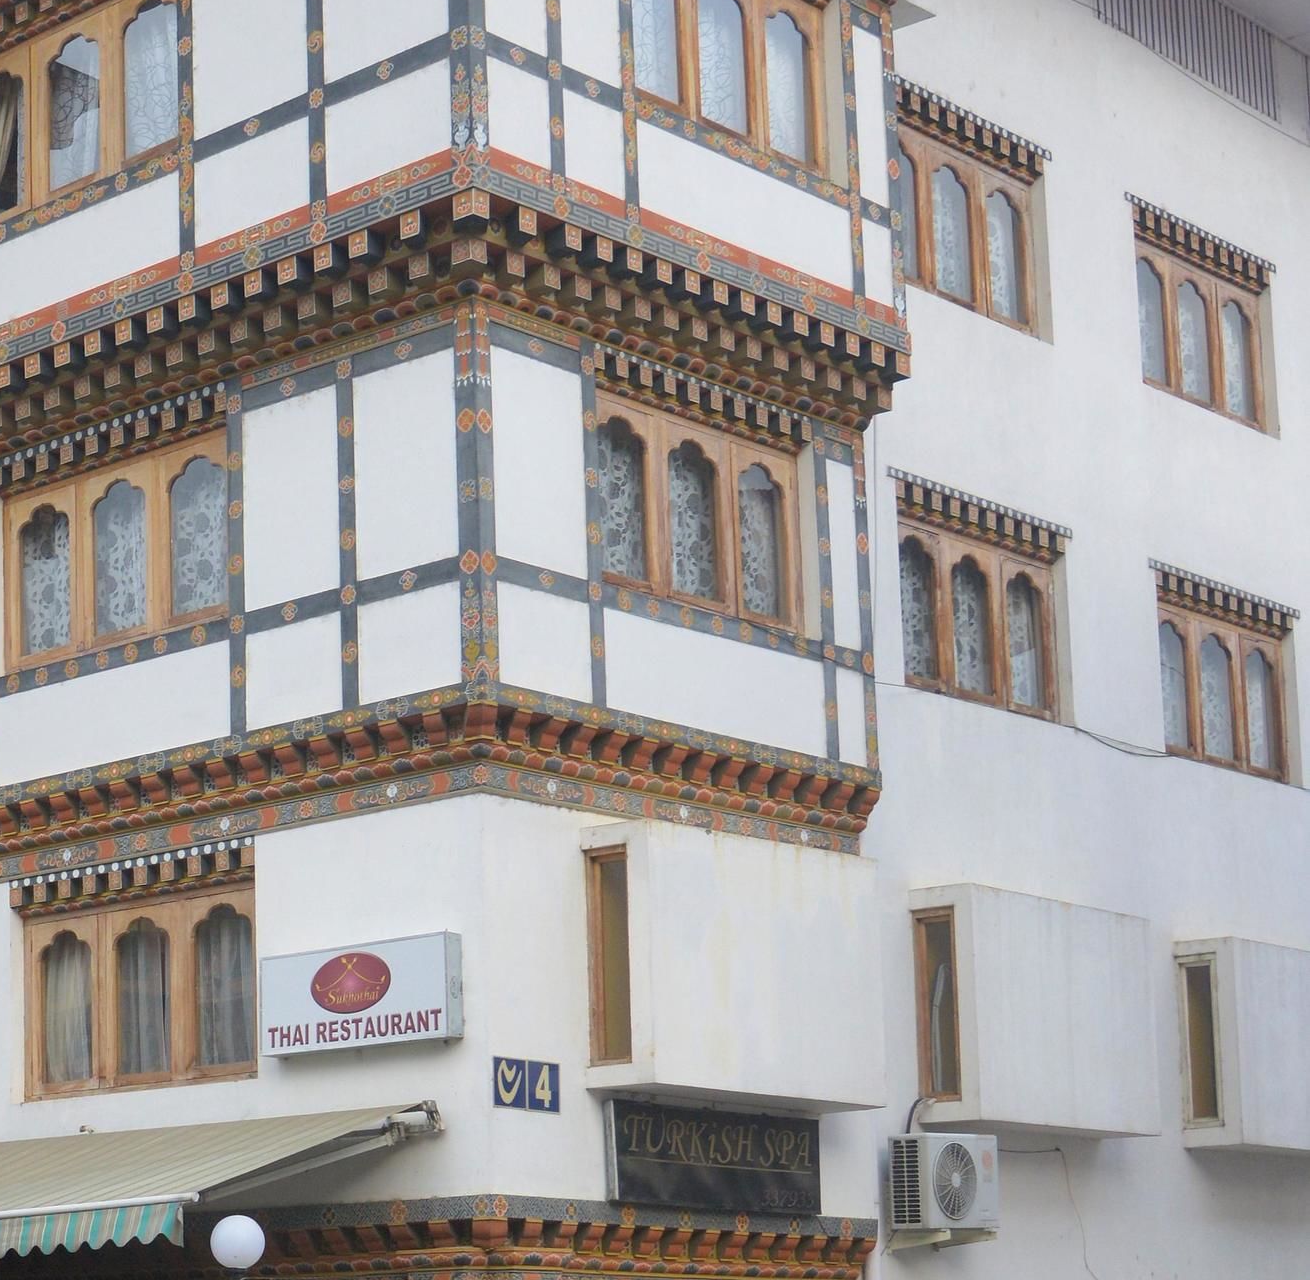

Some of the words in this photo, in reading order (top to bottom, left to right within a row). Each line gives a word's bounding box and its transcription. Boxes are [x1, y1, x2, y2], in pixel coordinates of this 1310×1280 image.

[325, 986, 379, 1005] Sukhothai
[267, 1023, 309, 1049] THAI
[316, 1008, 442, 1043] RESTAURANT
[535, 1064, 552, 1108] 4
[759, 1128, 812, 1170] SPA
